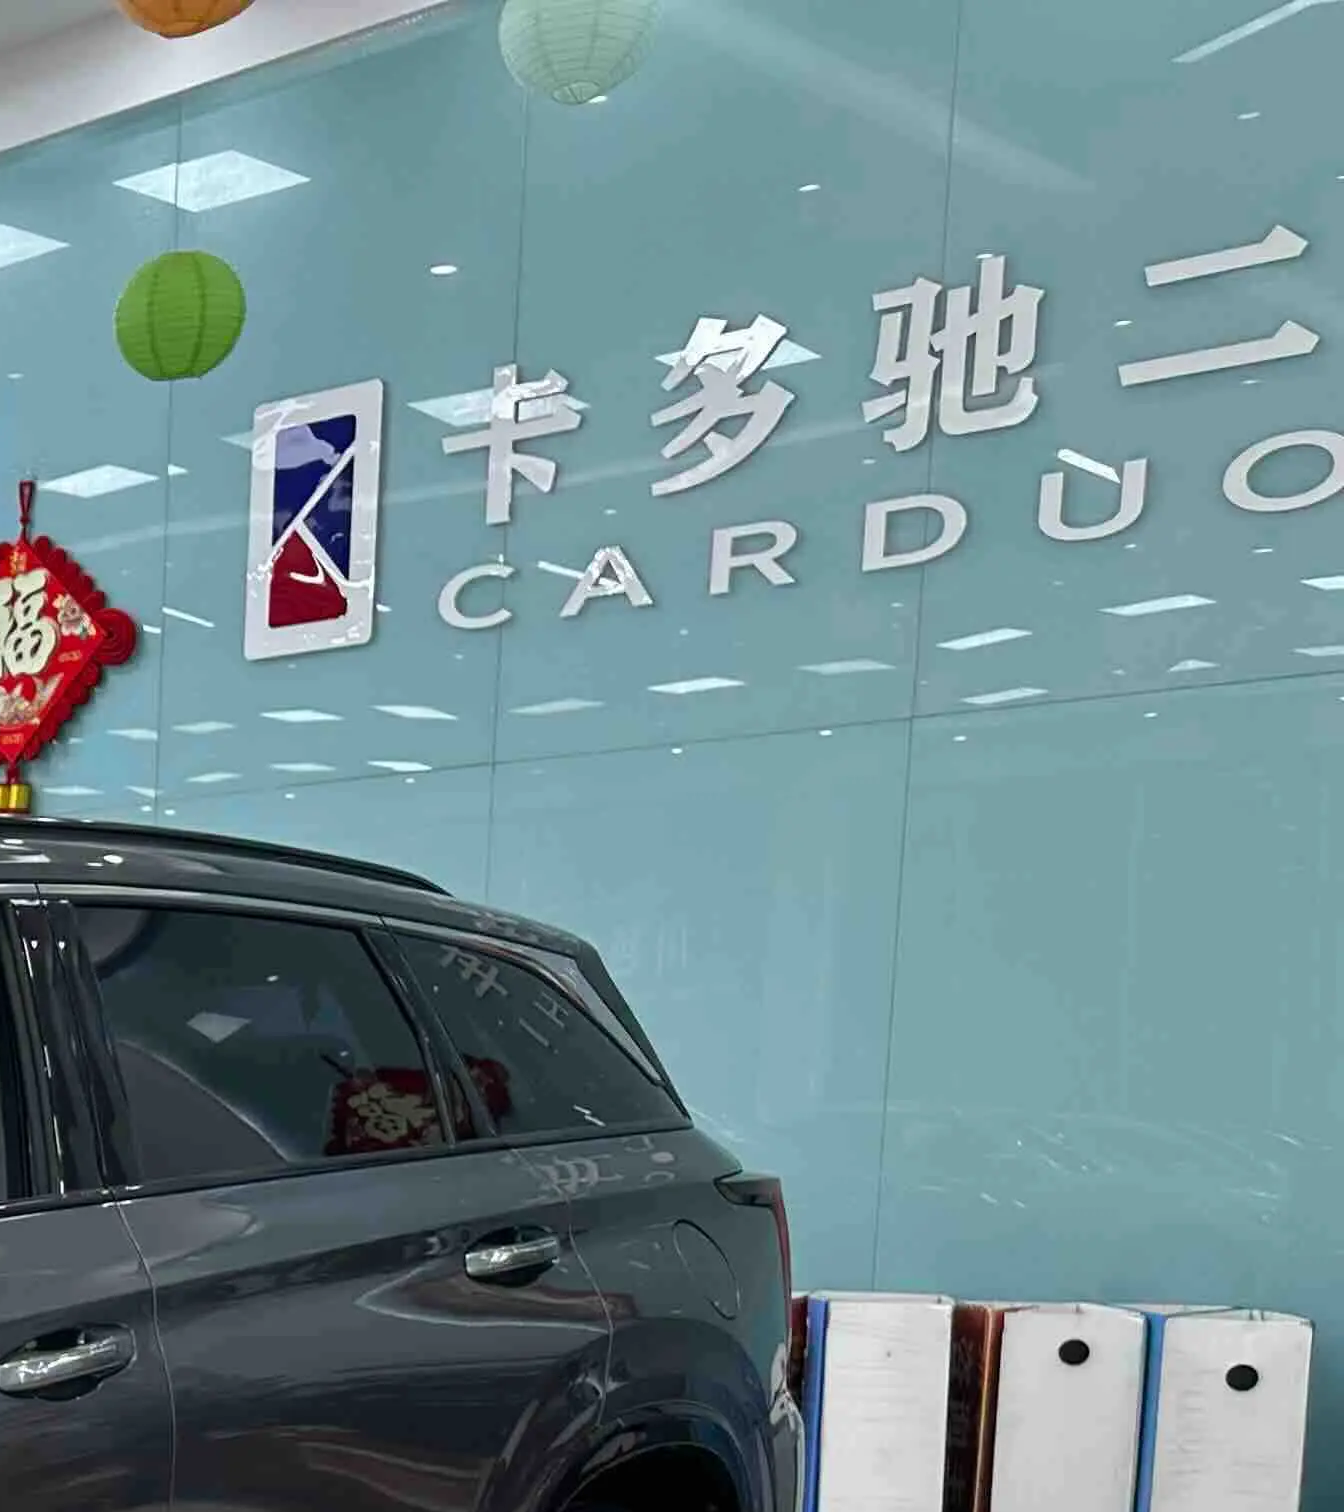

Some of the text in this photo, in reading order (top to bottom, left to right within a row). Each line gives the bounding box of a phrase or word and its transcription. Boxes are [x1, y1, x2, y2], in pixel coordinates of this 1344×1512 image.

[441, 224, 1320, 526] 卡多驰二
[437, 429, 1344, 630] CARDUO
